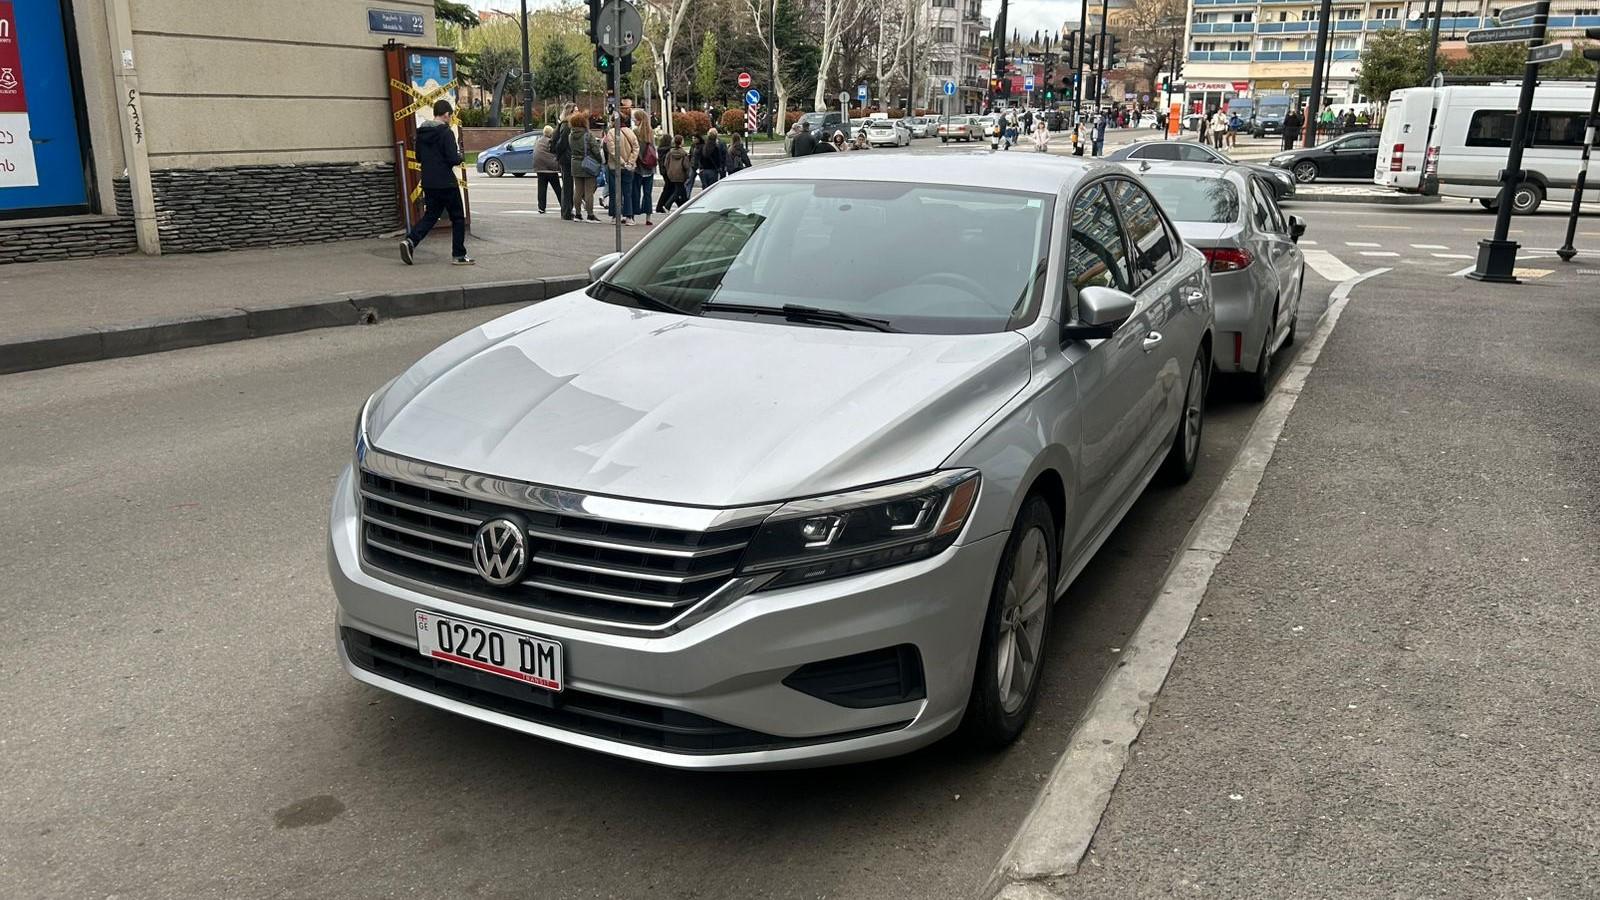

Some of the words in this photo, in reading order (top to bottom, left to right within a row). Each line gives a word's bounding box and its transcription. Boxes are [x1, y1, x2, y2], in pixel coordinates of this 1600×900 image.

[411, 15, 424, 28] 22
[418, 621, 429, 632] GE
[436, 618, 505, 667] 0220
[518, 637, 556, 681] DM
[522, 673, 551, 687] TRANSIT
